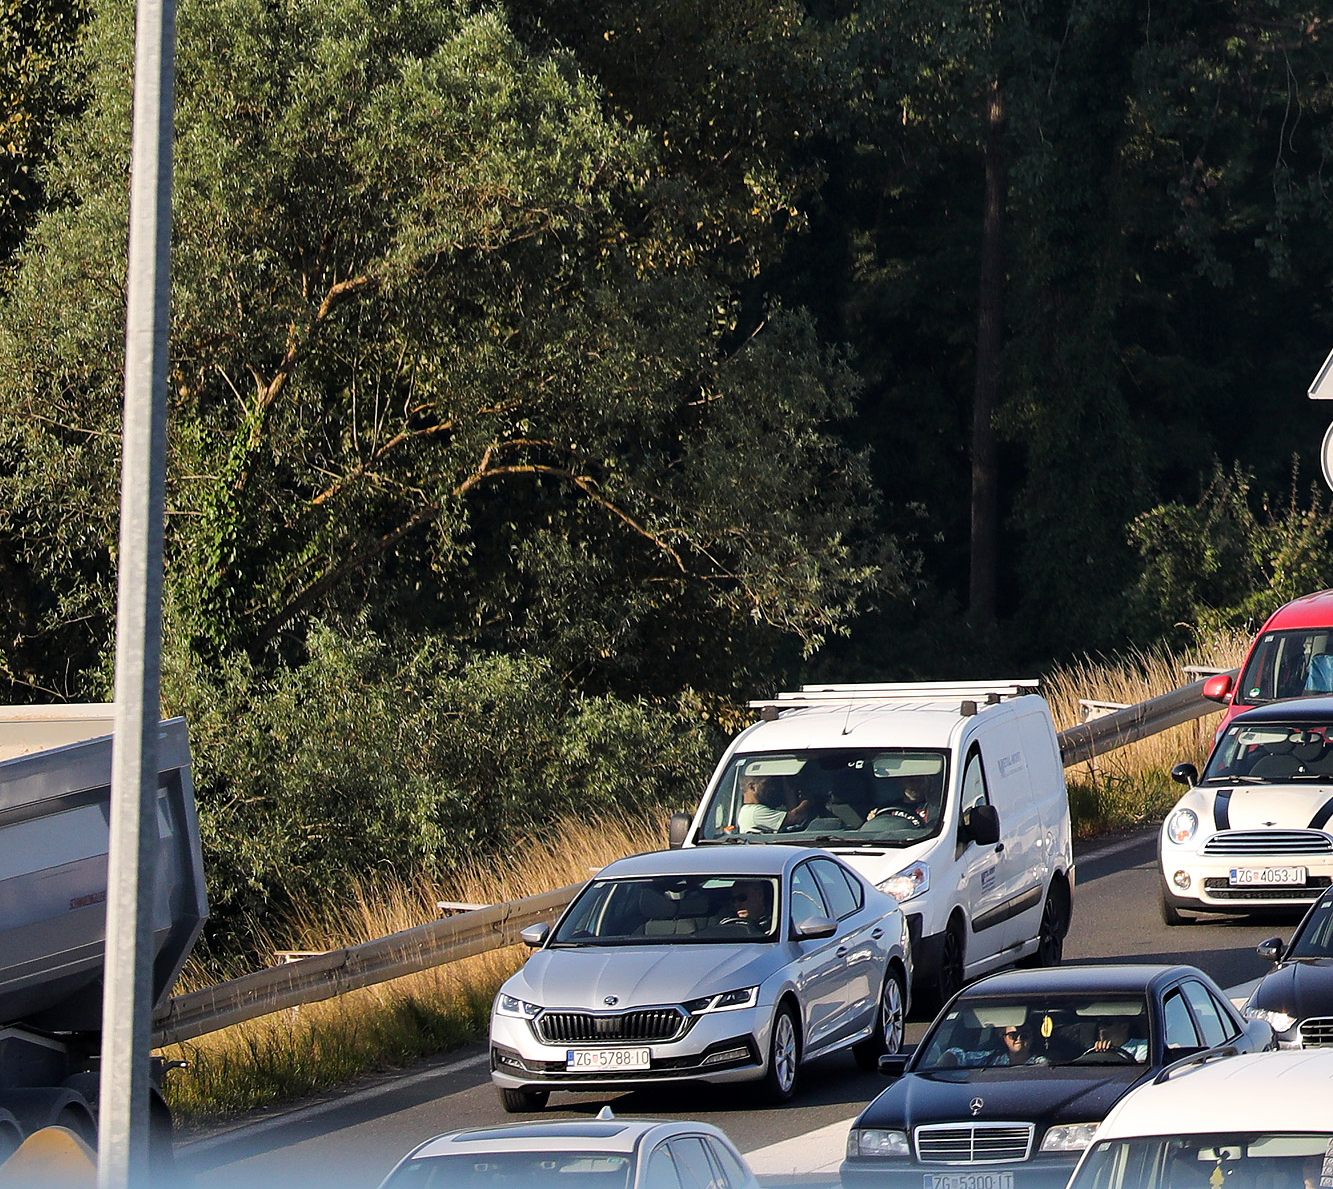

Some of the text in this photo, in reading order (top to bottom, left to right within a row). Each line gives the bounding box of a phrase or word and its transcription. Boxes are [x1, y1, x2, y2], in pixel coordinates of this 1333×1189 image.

[1239, 869, 1253, 883] ZG
[576, 1052, 592, 1066] ZG
[933, 1176, 950, 1189] ZG
